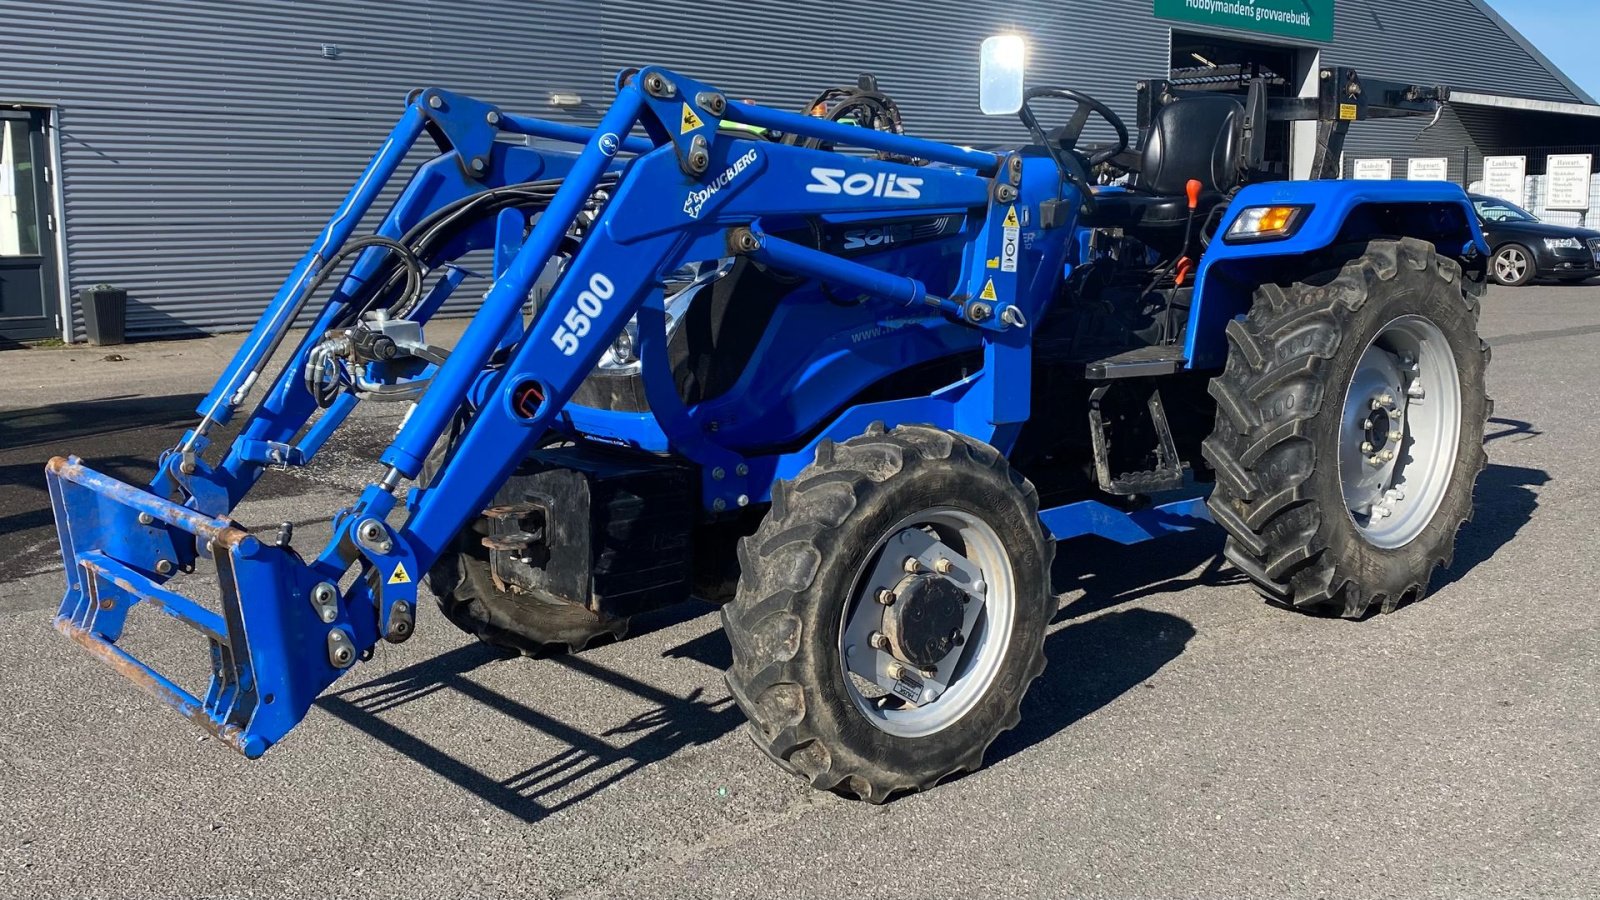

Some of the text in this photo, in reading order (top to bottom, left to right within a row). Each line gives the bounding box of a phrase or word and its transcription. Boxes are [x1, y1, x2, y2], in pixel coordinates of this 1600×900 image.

[1255, 7, 1310, 26] grovvarebutik
[697, 148, 757, 203] DAUGBJERG
[551, 272, 615, 356] 5500
